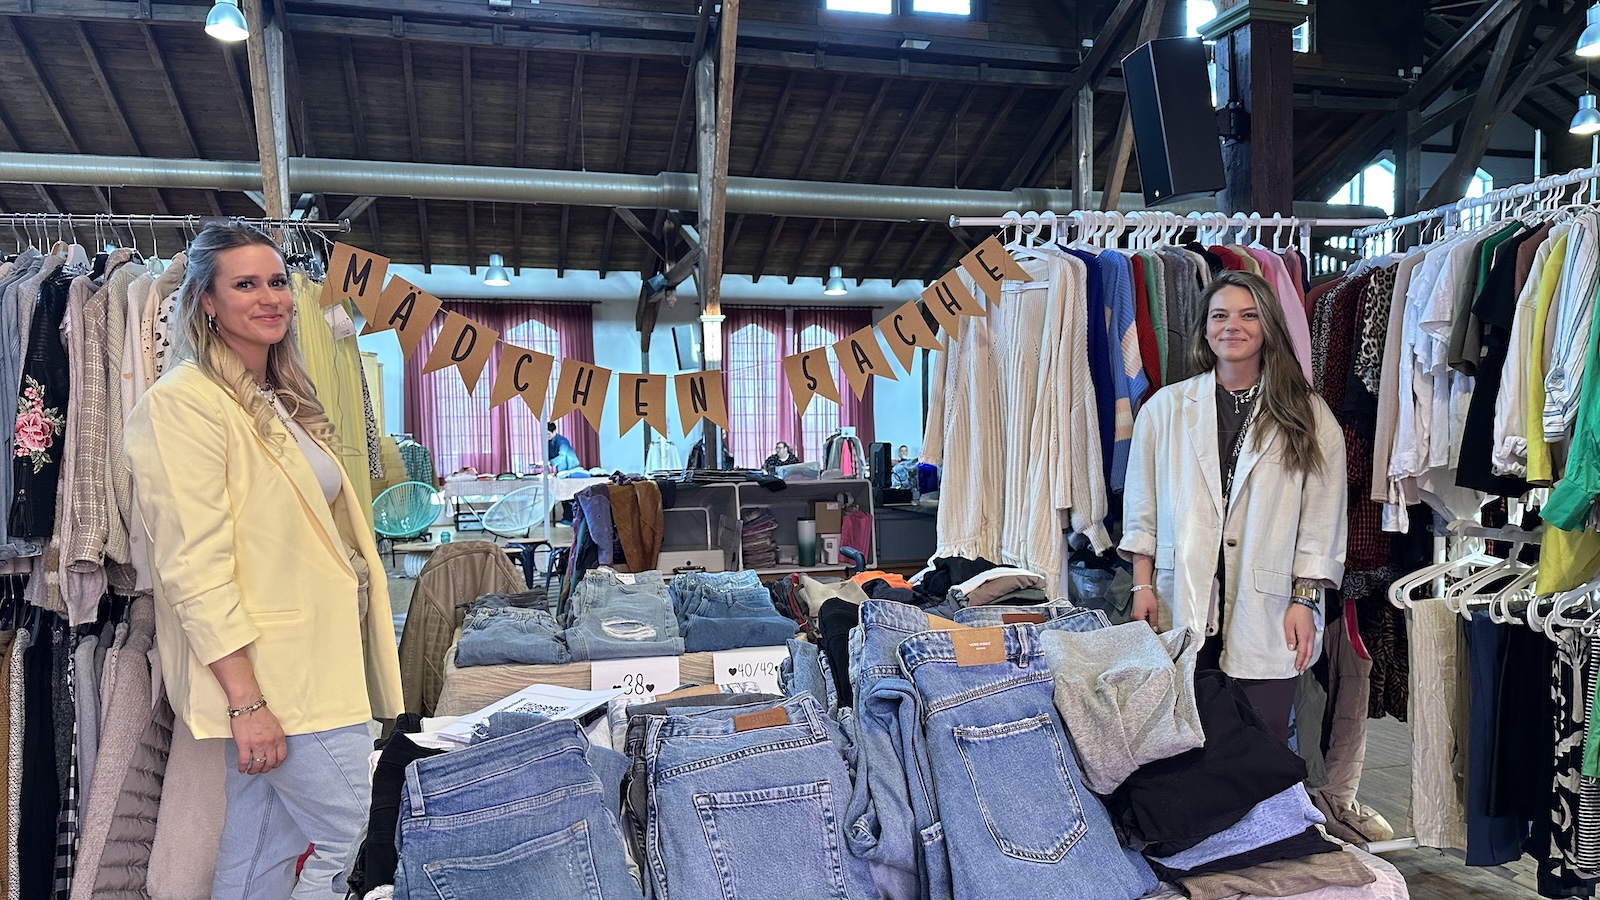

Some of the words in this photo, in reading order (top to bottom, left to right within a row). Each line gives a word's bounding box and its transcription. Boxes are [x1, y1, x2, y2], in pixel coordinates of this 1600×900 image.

[342, 253, 706, 417] MÄDCHEN
[802, 249, 1004, 391] SACHE
[737, 661, 774, 677] 40/42
[623, 673, 645, 695] 38
